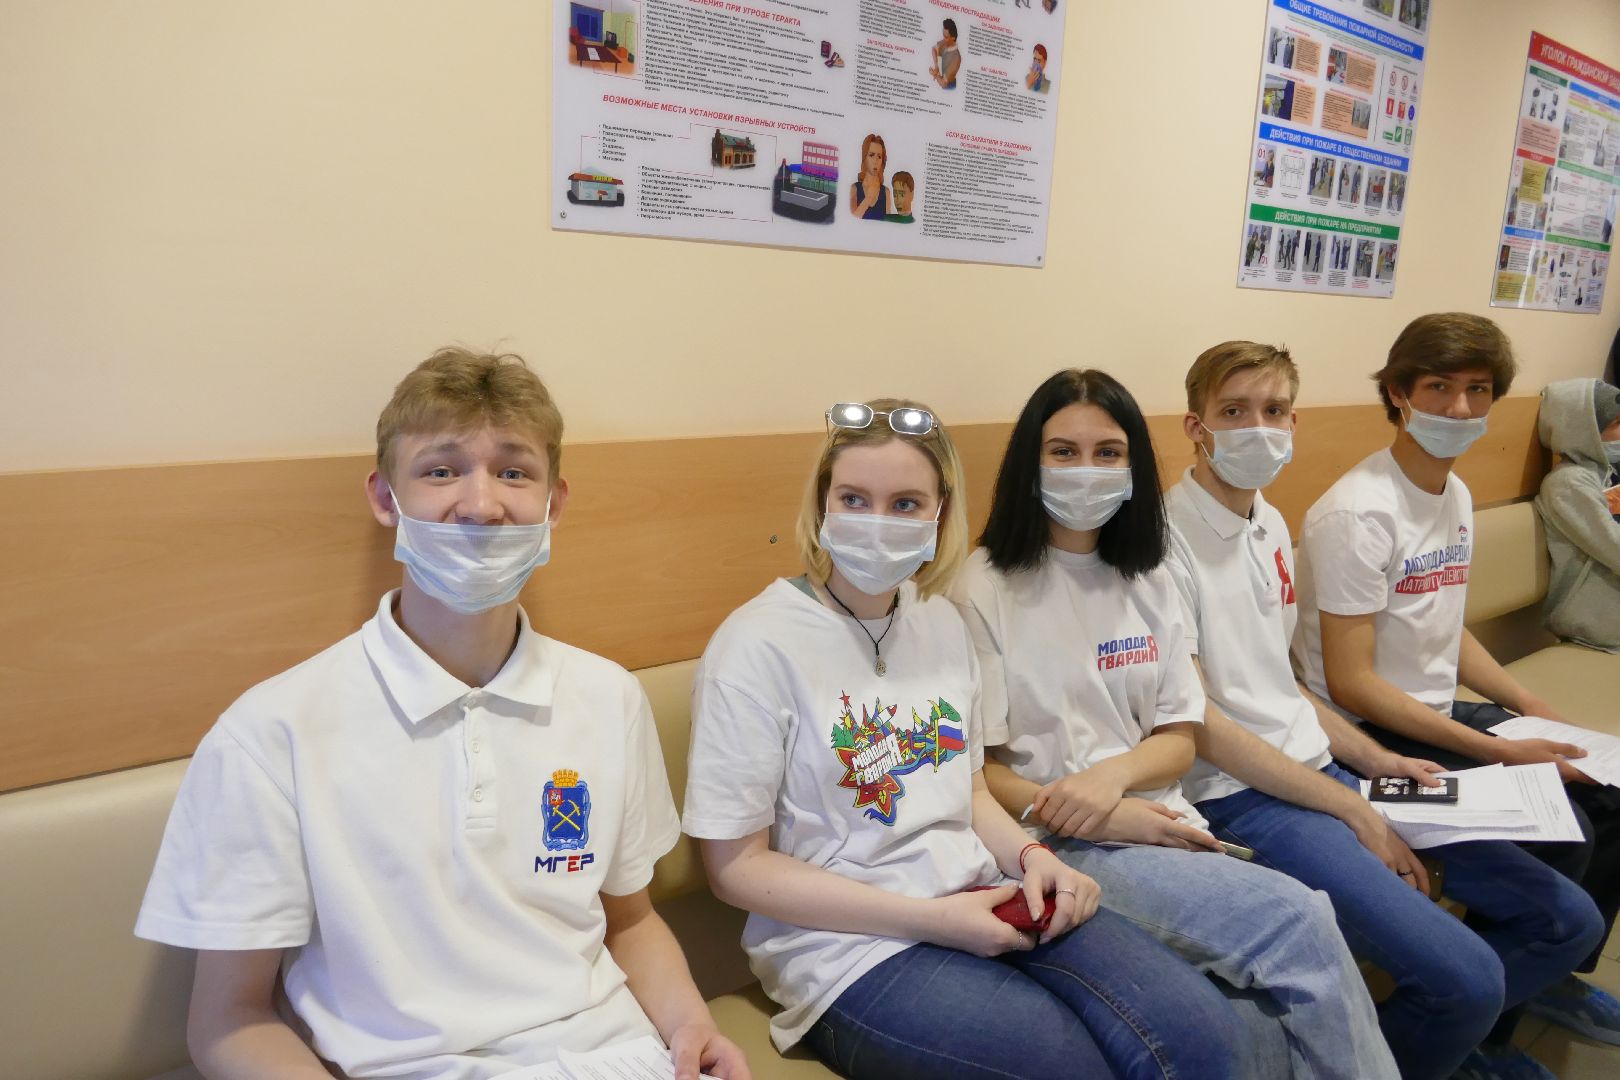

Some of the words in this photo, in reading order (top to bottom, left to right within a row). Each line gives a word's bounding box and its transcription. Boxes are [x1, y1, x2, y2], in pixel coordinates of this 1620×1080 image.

[725, 2, 741, 12] ПРИ
[742, 5, 770, 19] УГРОЗЕ
[770, 12, 801, 27] ТЕРАКТА
[1312, 8, 1347, 30] ТРЕБОВАНИЯ
[602, 94, 658, 110] ВОЗМОЖНЫЕ
[660, 103, 688, 114] МЕСТА
[688, 108, 733, 122] УСТАНОВКИ
[734, 115, 776, 128] ВЗРЫВНЫХ
[777, 120, 816, 134] УСТРОЙСТВ
[1270, 128, 1300, 144] ДЕЙСТВИЯ
[1302, 136, 1314, 146] ПРИ
[1315, 138, 1337, 152] ПОЖАРЕ
[1274, 211, 1304, 224] ДЕЙСТВИЯ
[1306, 216, 1317, 226] ПРИ
[1318, 217, 1339, 230] ПОЖАРЕ
[534, 853, 594, 873] МГЕР
